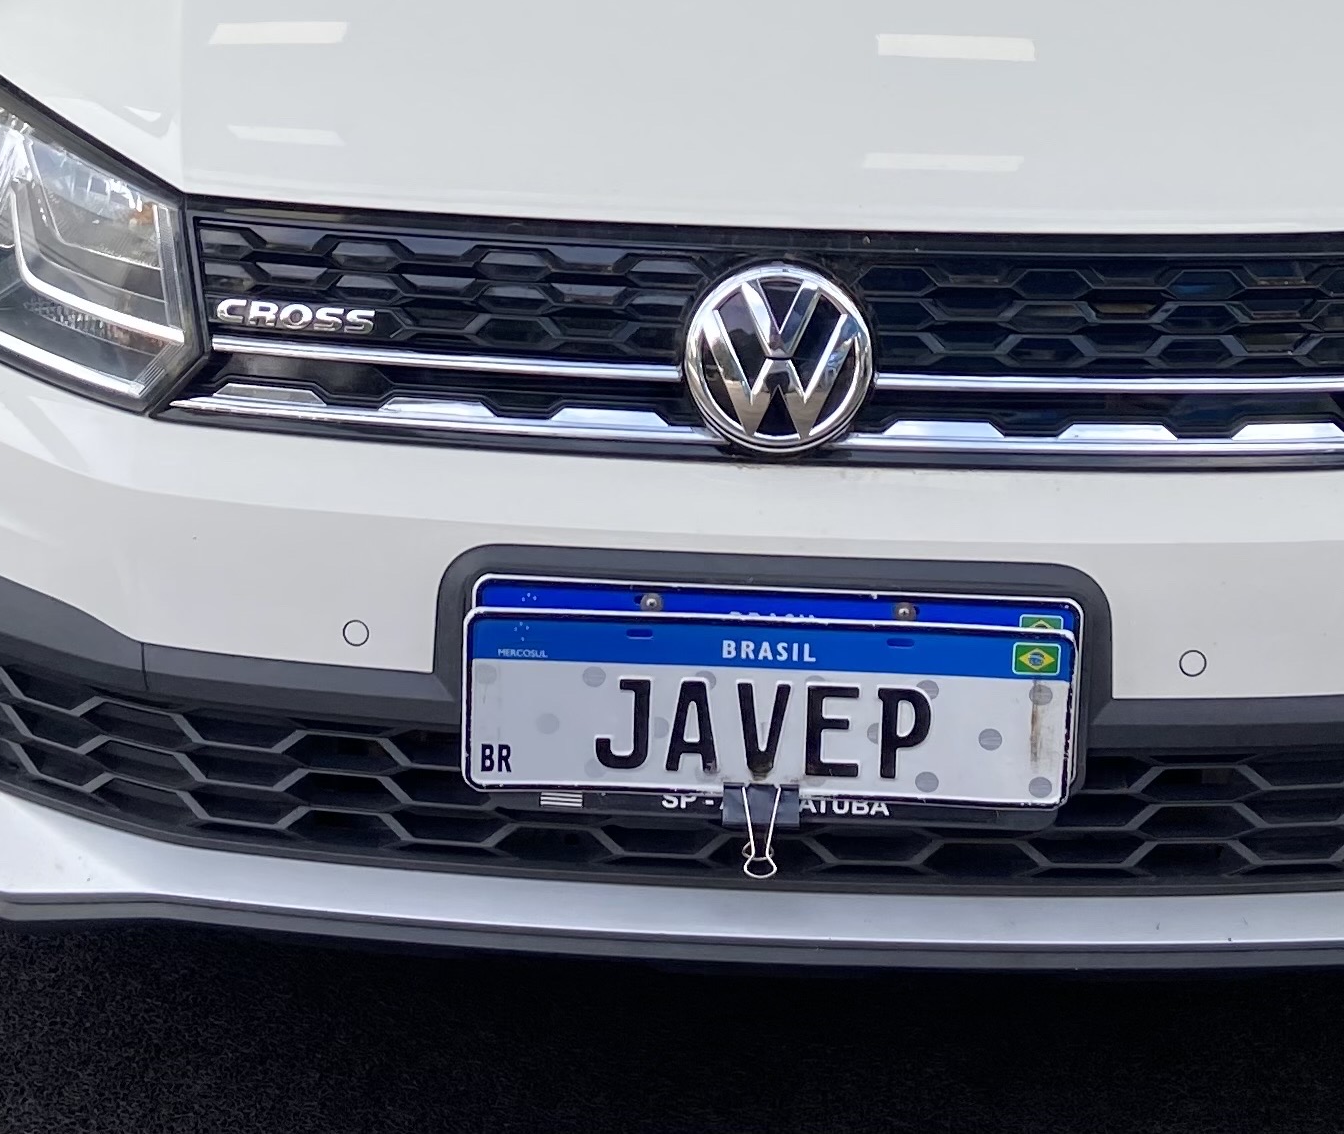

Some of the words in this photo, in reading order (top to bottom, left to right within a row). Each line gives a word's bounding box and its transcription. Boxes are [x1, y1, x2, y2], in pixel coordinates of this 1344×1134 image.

[216, 298, 376, 336] CROSS
[497, 648, 549, 659] MERCOSUL
[721, 639, 817, 663] BRASIL
[594, 677, 933, 780] JAVEP
[480, 743, 512, 773] BR
[661, 795, 697, 810] SP
